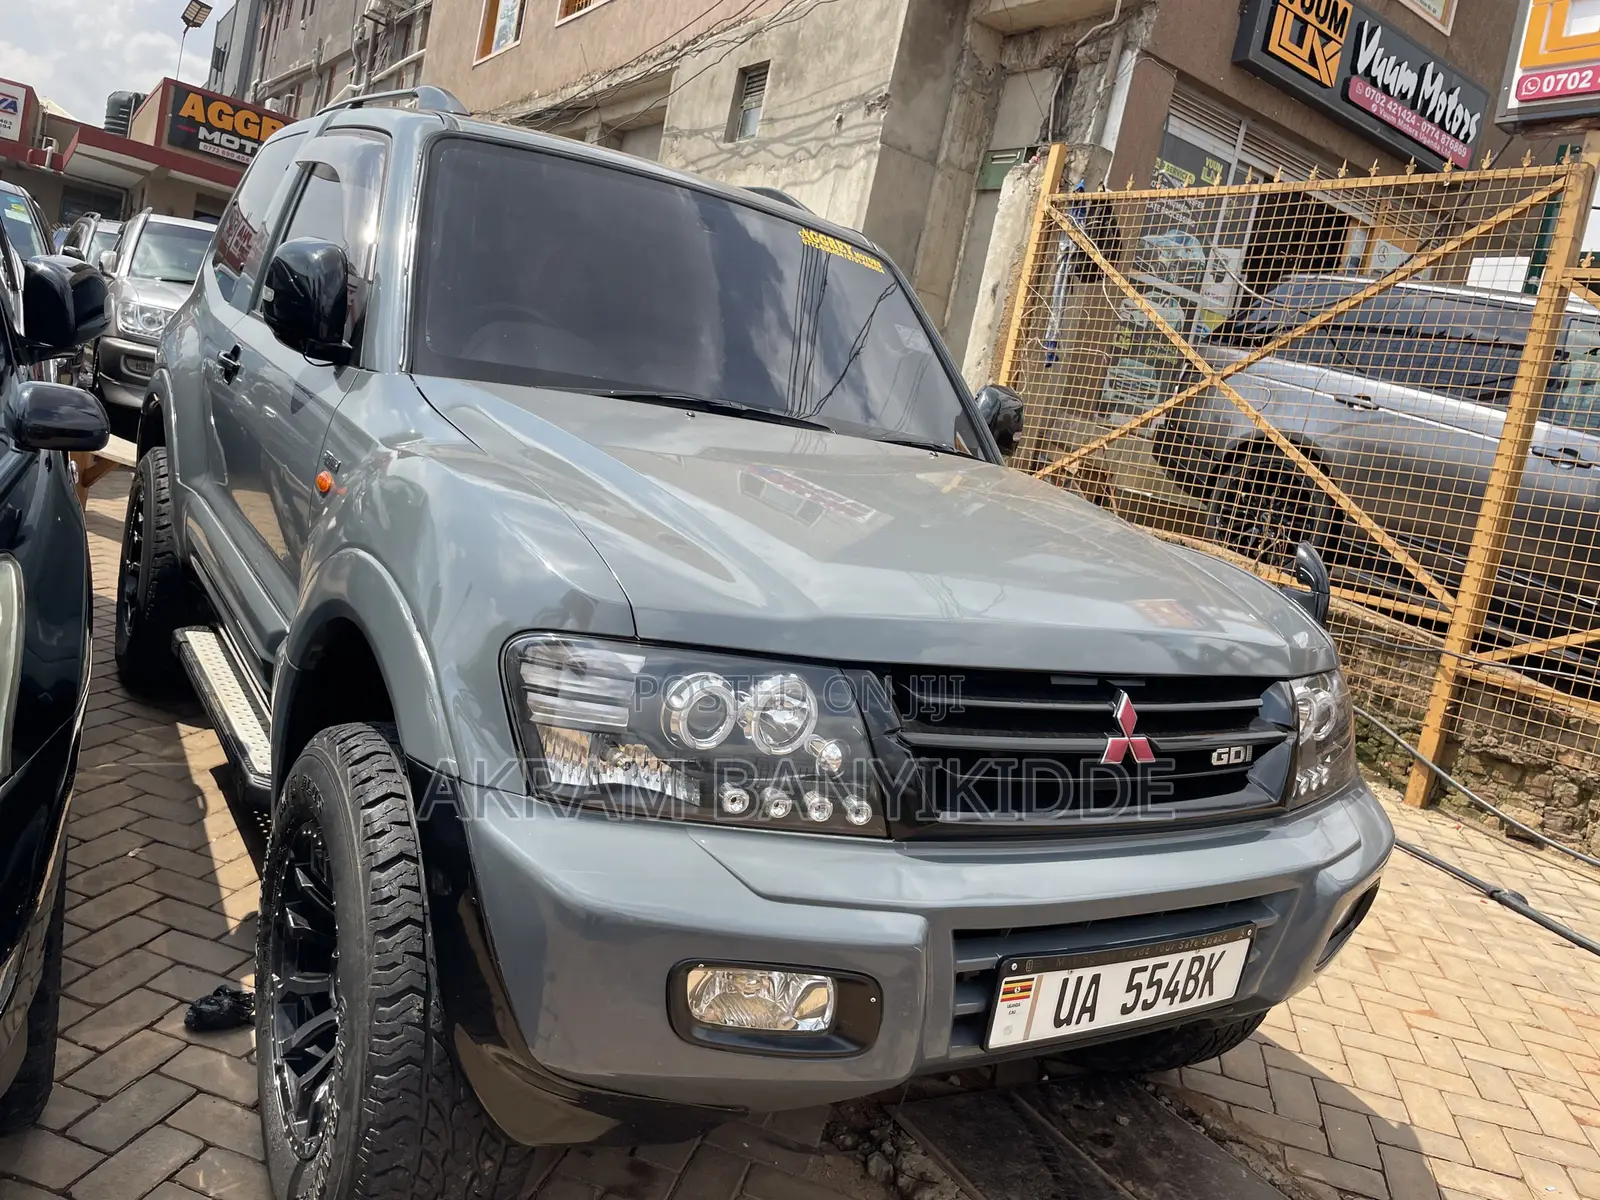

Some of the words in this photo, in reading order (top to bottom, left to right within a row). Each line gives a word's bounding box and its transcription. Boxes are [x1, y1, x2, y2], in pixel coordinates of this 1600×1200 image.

[1285, 0, 1349, 39] UUM
[1357, 20, 1418, 99] Vuum
[1417, 62, 1481, 144] Motors
[1542, 70, 1593, 93] 0702
[1365, 86, 1386, 108] 0702
[1387, 100, 1417, 126] 421424
[1421, 121, 1440, 140] 0774
[198, 127, 261, 154] MOT
[1211, 745, 1253, 766] GDI
[1179, 939, 1198, 950] Safe
[1202, 933, 1228, 946] Space
[1053, 973, 1101, 1028] UA
[1120, 950, 1226, 1016] 554BK
